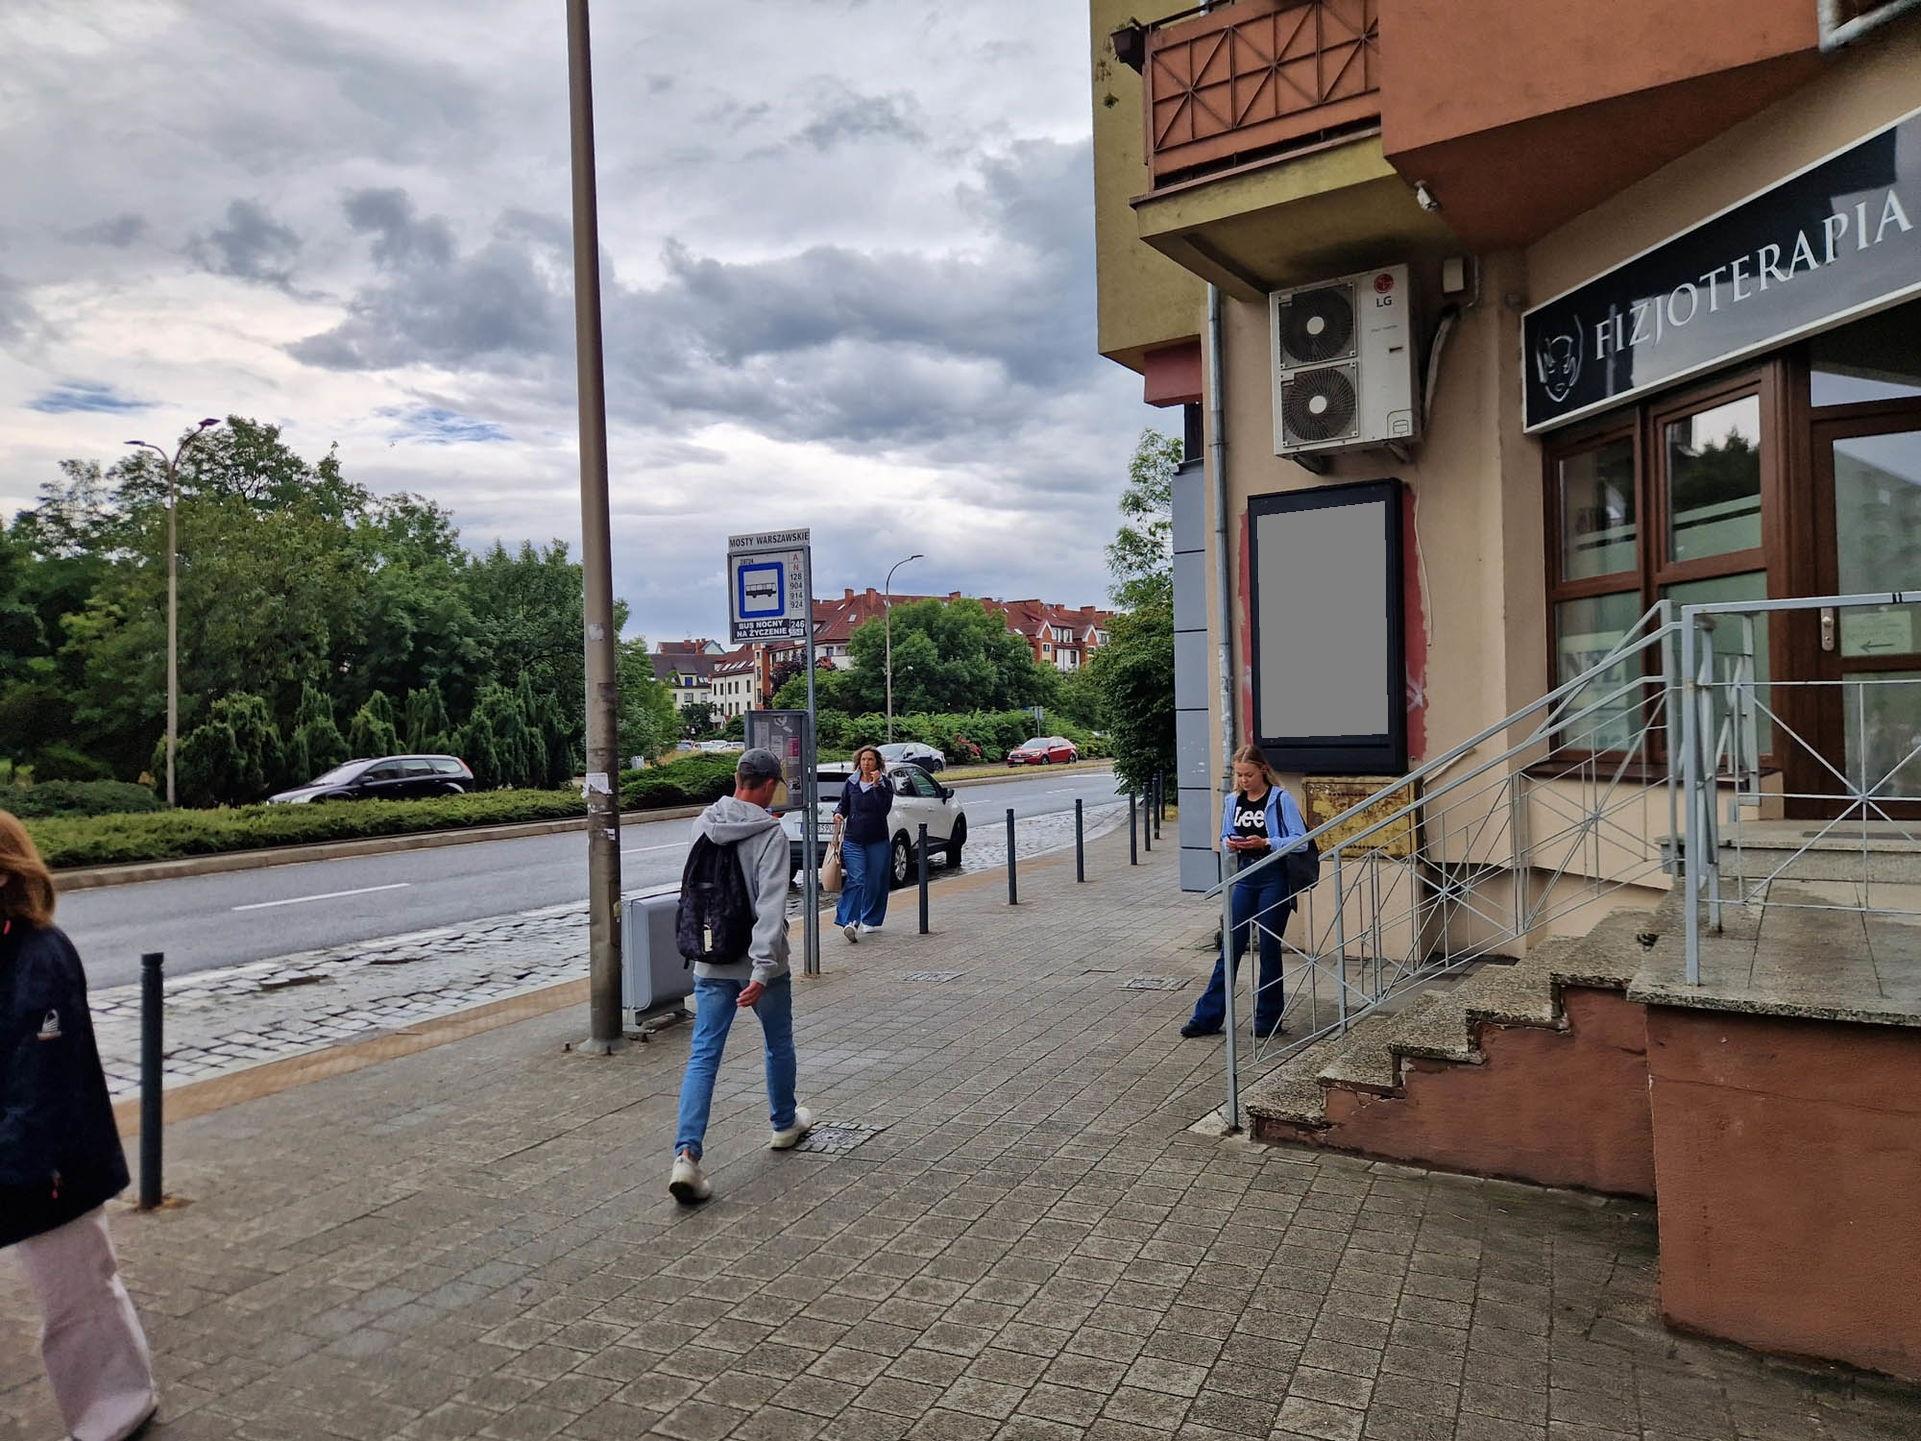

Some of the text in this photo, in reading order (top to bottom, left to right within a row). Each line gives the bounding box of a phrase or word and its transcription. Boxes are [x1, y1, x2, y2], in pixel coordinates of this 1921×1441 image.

[1594, 189, 1914, 360] FIZJOTERAPIA
[1376, 295, 1392, 307] LG
[729, 531, 810, 548] MOSTY WARSZAWSKIE
[793, 553, 798, 561] A
[793, 563, 799, 571] N
[790, 572, 802, 581] 128
[790, 600, 803, 609] 924
[738, 620, 783, 630] BUS NOCNY
[790, 620, 804, 628] 246
[749, 627, 787, 637] ŻYCZENIE
[1233, 806, 1265, 828] Lee
